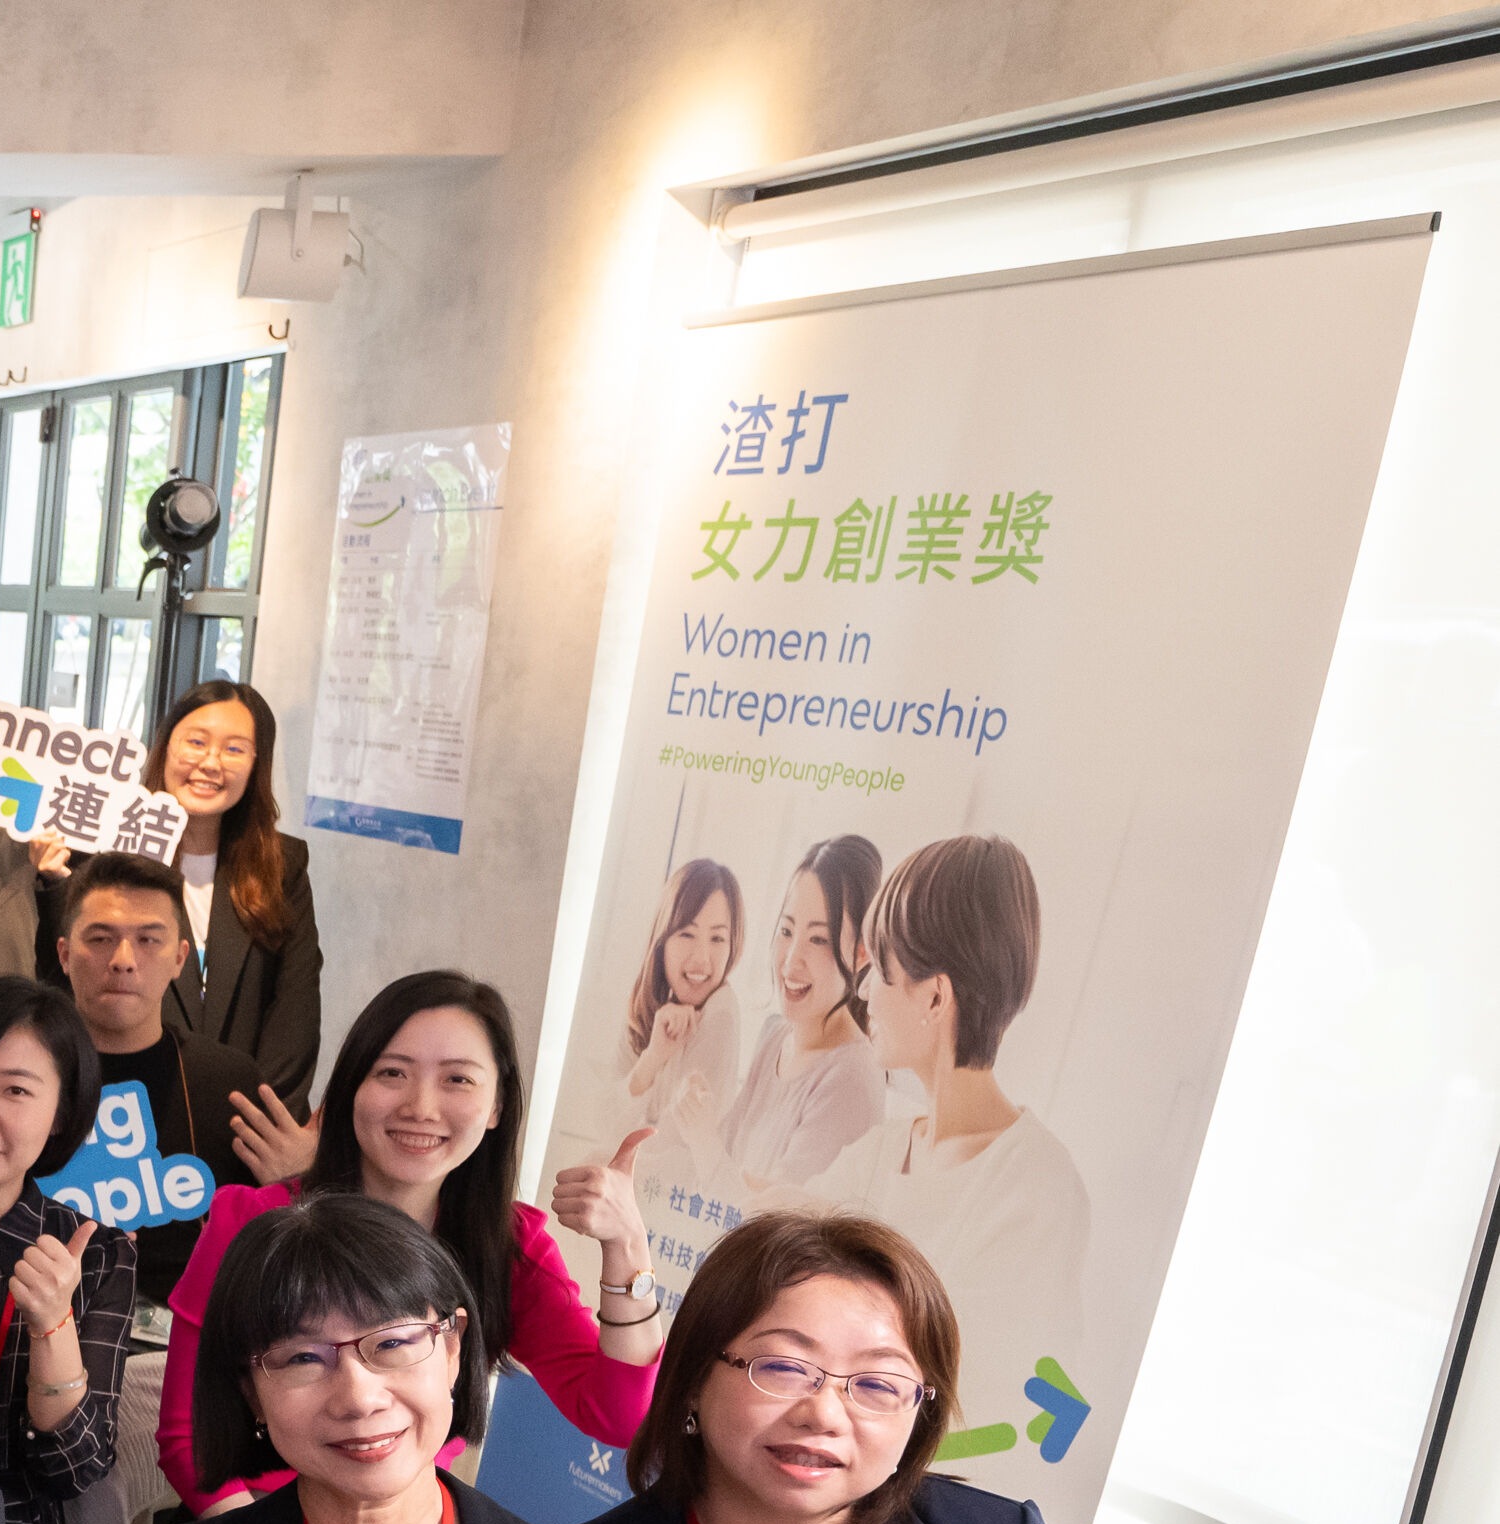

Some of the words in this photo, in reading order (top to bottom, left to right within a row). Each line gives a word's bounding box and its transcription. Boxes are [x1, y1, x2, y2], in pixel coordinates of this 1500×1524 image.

[713, 389, 849, 476] 渣打
[691, 489, 1055, 586] 女力創業獎
[681, 612, 828, 665] Women
[838, 622, 872, 666] in
[666, 672, 1009, 756] Entrepreneurship
[658, 745, 906, 797] #PoweringYoungPeople
[43, 774, 183, 867] 連結
